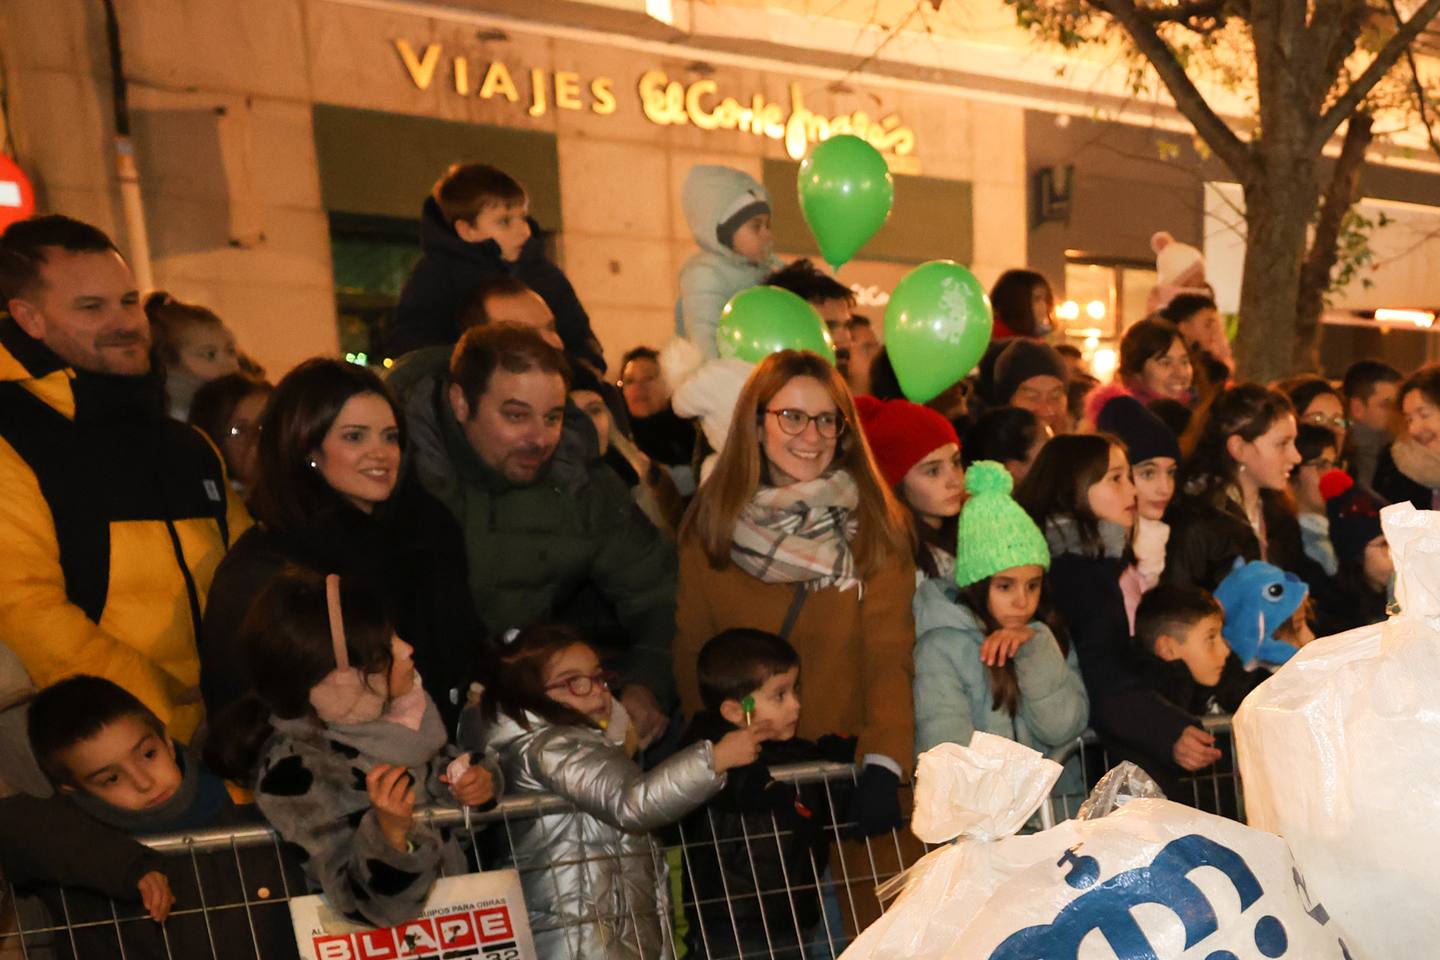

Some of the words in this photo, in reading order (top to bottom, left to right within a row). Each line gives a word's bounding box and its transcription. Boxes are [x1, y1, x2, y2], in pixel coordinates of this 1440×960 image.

[397, 39, 616, 117] VIAJES
[417, 907, 450, 918] QUIPOS
[452, 902, 475, 912] PARA
[476, 898, 507, 909] OBRAS
